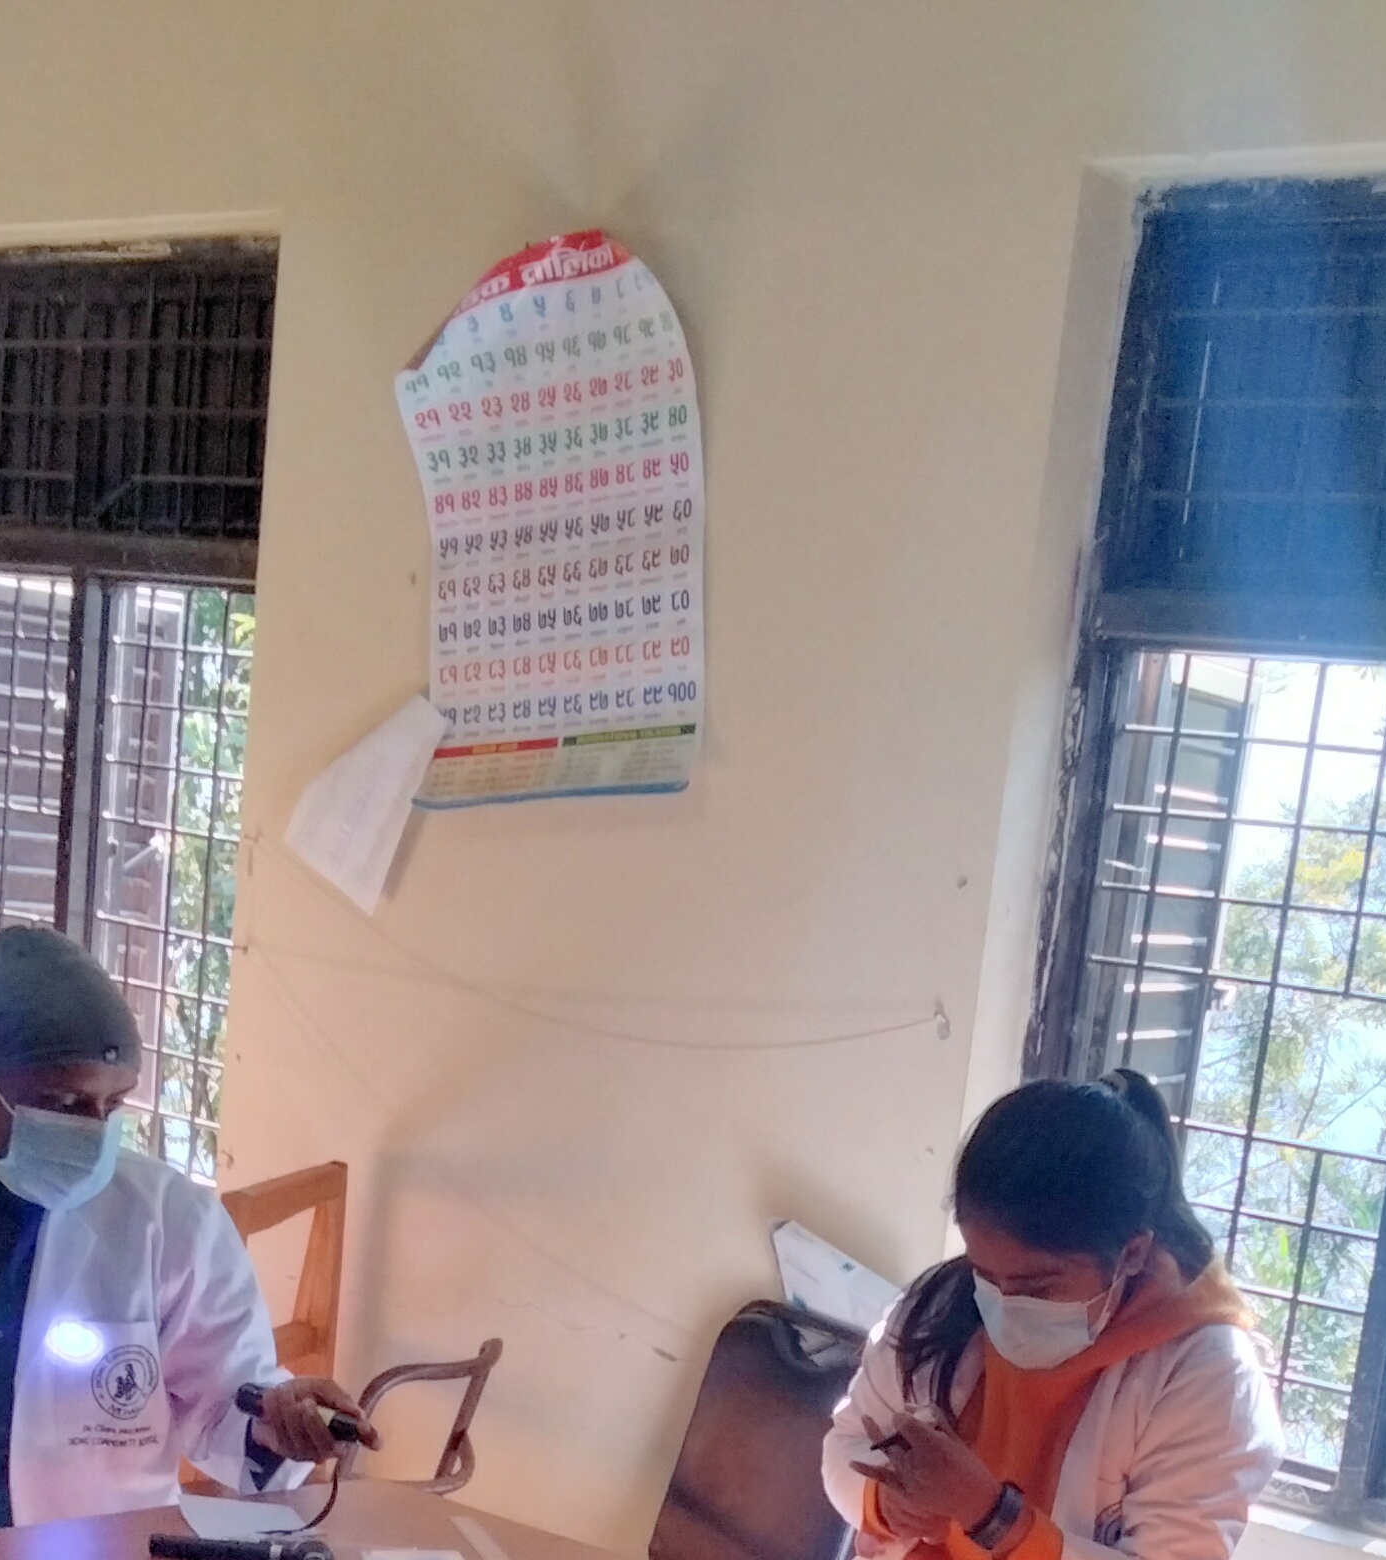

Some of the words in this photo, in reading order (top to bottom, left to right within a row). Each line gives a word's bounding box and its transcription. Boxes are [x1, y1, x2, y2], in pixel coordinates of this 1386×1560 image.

[519, 243, 614, 284] तालिका
[437, 361, 462, 381] १२
[471, 352, 496, 373] १३
[504, 346, 527, 367] १४
[535, 341, 555, 363] १५
[562, 335, 580, 357] १६
[588, 330, 606, 351] १७
[613, 323, 631, 345] १८
[639, 319, 655, 338] १९
[415, 409, 441, 429] २१
[449, 402, 473, 422] २२
[481, 396, 503, 418] २३
[511, 391, 530, 413] २४
[538, 386, 556, 408] २५
[564, 382, 582, 403] २६
[590, 377, 607, 397] २७
[615, 371, 632, 392] २८
[641, 366, 658, 385] २९
[668, 357, 683, 382] ३०
[427, 450, 451, 472] ३१
[459, 445, 478, 468] ३२
[487, 441, 506, 464] ३३
[514, 437, 531, 459] ३४
[539, 432, 556, 454] ३५
[564, 426, 582, 450] ३६
[590, 422, 608, 445] ३७
[615, 416, 633, 440] ३८
[641, 411, 659, 435] ३९
[669, 405, 687, 427] ४०
[435, 493, 454, 514] ४१
[462, 490, 480, 510] ४२
[489, 486, 508, 506] ४३
[515, 482, 532, 502] ४४
[540, 477, 557, 497] ४५
[565, 472, 583, 493] ४६
[590, 468, 609, 489] ४७
[616, 463, 634, 484] ४८
[643, 458, 661, 479] ४९
[670, 452, 689, 475] ५०
[440, 537, 458, 559] ५१
[465, 534, 483, 555] ५२
[490, 530, 507, 551] ५३
[515, 526, 533, 547] ५४
[540, 520, 558, 543] ५५
[565, 517, 583, 539] ५६
[591, 513, 610, 535] ५७
[617, 508, 635, 531] ५८
[645, 505, 663, 526] ५९
[673, 499, 692, 522] ६०
[438, 579, 456, 601] ६१
[463, 576, 480, 597] ६२
[488, 572, 505, 594] ६३
[513, 568, 530, 590] ६४
[538, 564, 556, 586] ६५
[563, 561, 581, 583] ६६
[589, 558, 608, 579] ६७
[615, 553, 633, 575] ६८
[642, 549, 661, 571] ६९
[670, 544, 689, 565] ७०
[439, 623, 457, 642] ७१
[464, 619, 481, 639] ७२
[488, 616, 506, 636] ७३
[513, 612, 531, 633] ७४
[538, 609, 556, 629] ७५
[563, 605, 582, 626] ७६
[589, 603, 608, 622] ७७
[615, 598, 633, 619] ७८
[642, 595, 661, 615] ७९
[671, 590, 689, 611] ८०
[440, 665, 457, 684] ८१
[464, 662, 481, 682] ८२
[489, 659, 505, 679] ८३
[514, 656, 531, 676] ८४
[539, 652, 556, 673] ८५
[564, 650, 581, 670] ८६
[589, 647, 608, 667] ८७
[615, 643, 633, 663] ८८
[643, 640, 661, 660] ८९
[671, 636, 690, 656] ९०
[463, 705, 481, 724] ९२
[488, 703, 505, 722] ९३
[513, 700, 531, 719] ९४
[539, 696, 556, 717] ९५
[564, 694, 582, 714] ९६
[590, 691, 608, 711] ९७
[616, 688, 634, 708] ९८
[644, 686, 662, 705] ९९
[668, 681, 696, 702] १००
